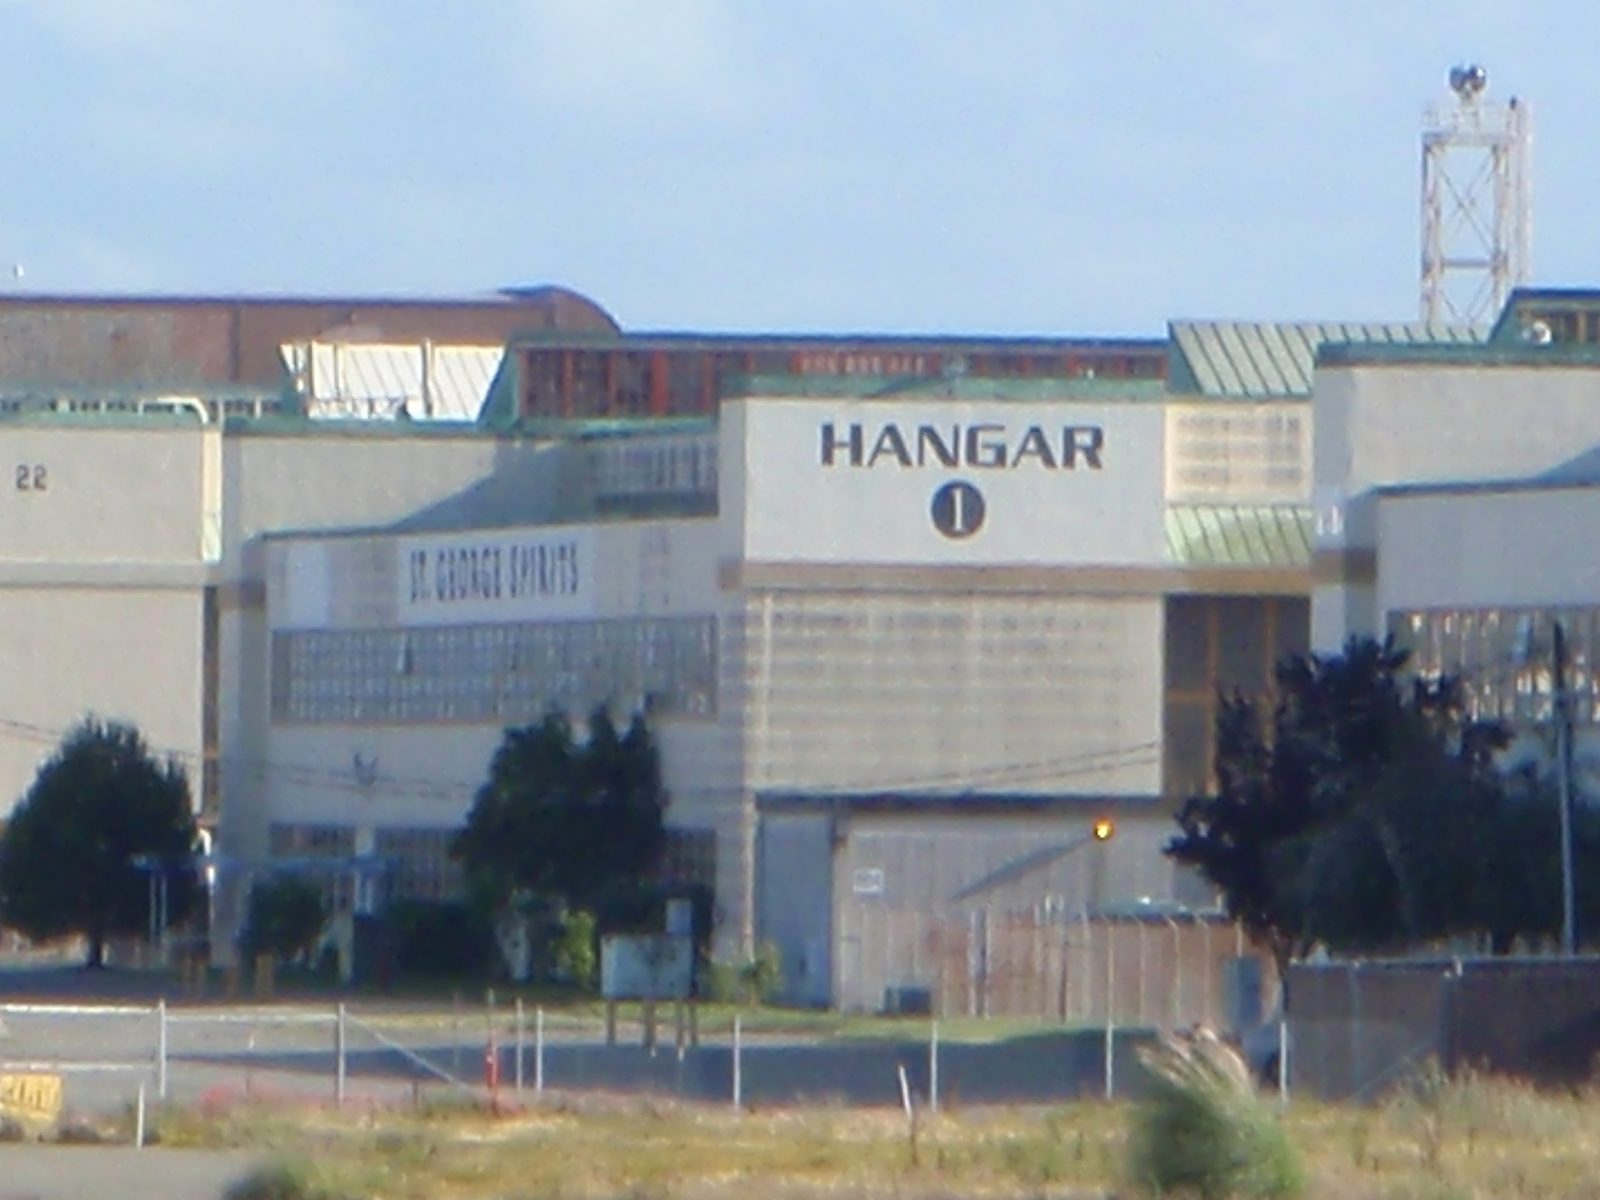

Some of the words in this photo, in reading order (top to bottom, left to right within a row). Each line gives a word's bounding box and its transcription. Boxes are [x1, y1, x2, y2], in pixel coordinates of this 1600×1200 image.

[821, 423, 1103, 469] HANGAR
[16, 464, 47, 491] 22
[436, 547, 500, 600] GEORGE
[511, 543, 578, 597] SPIRITS
